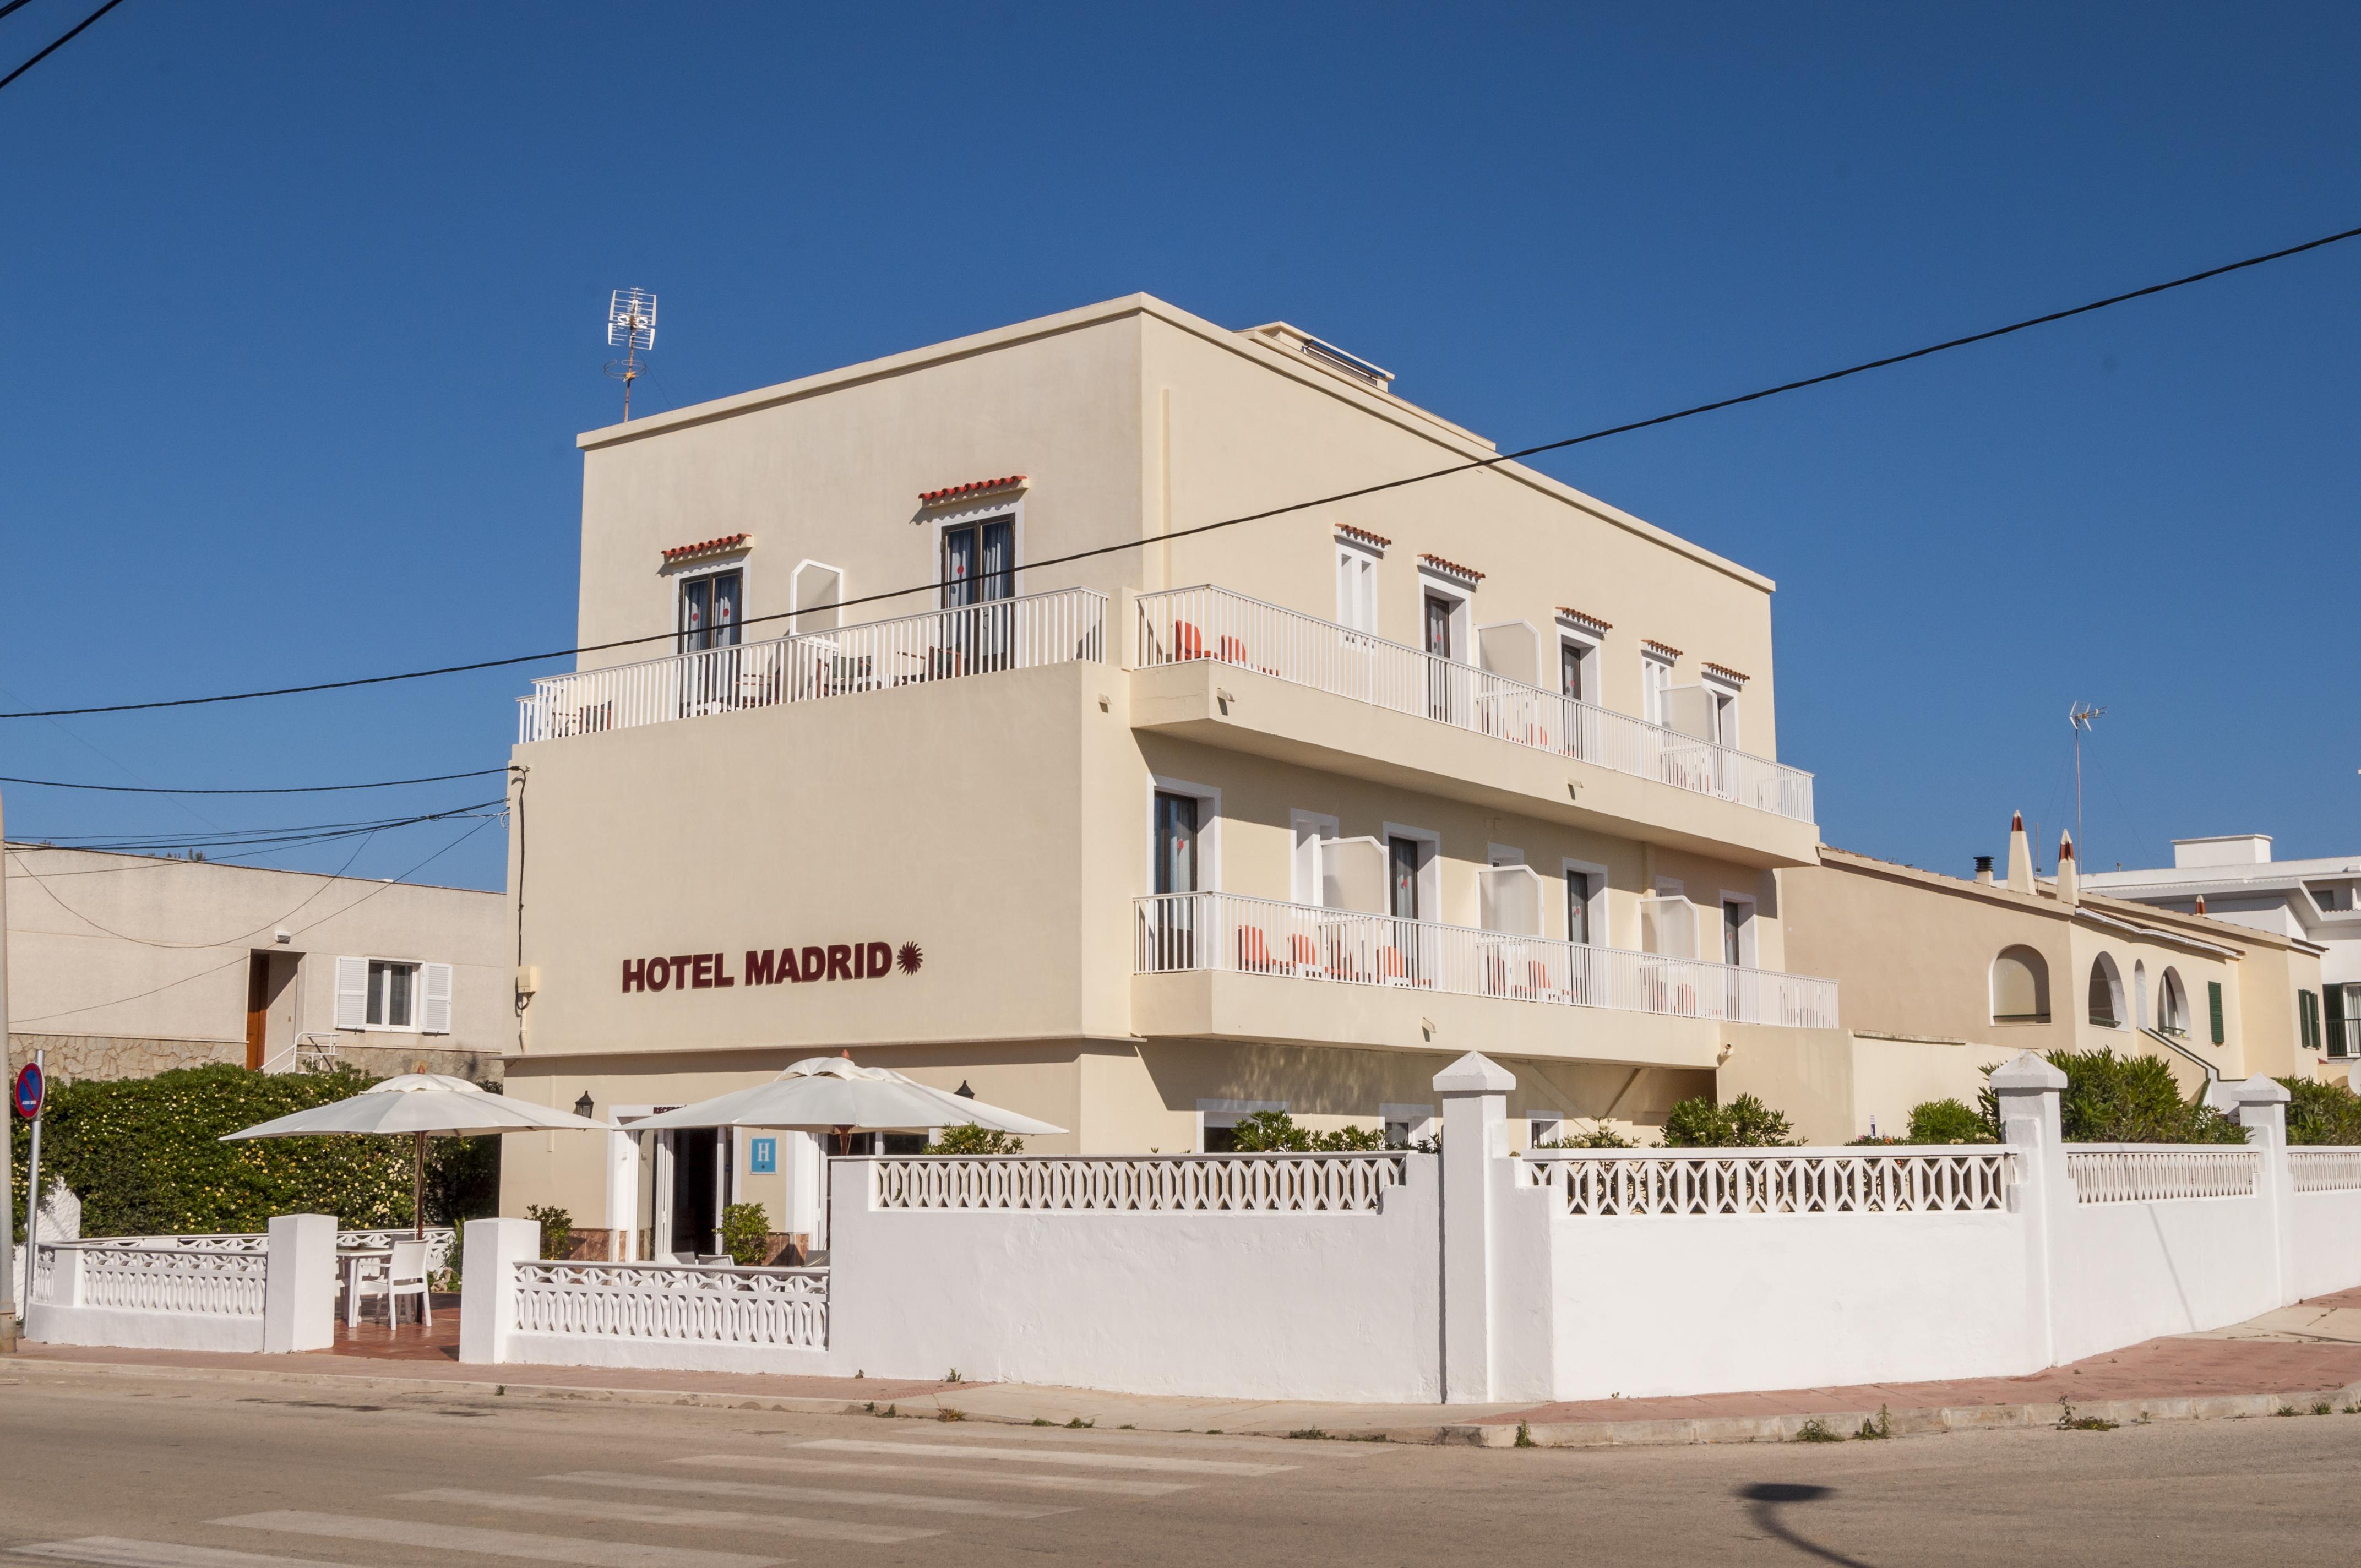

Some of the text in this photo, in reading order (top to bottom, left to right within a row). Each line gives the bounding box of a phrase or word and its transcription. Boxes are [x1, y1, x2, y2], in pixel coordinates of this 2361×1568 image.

[622, 941, 893, 993] HOTEL MADRID
[758, 1142, 770, 1162] H
